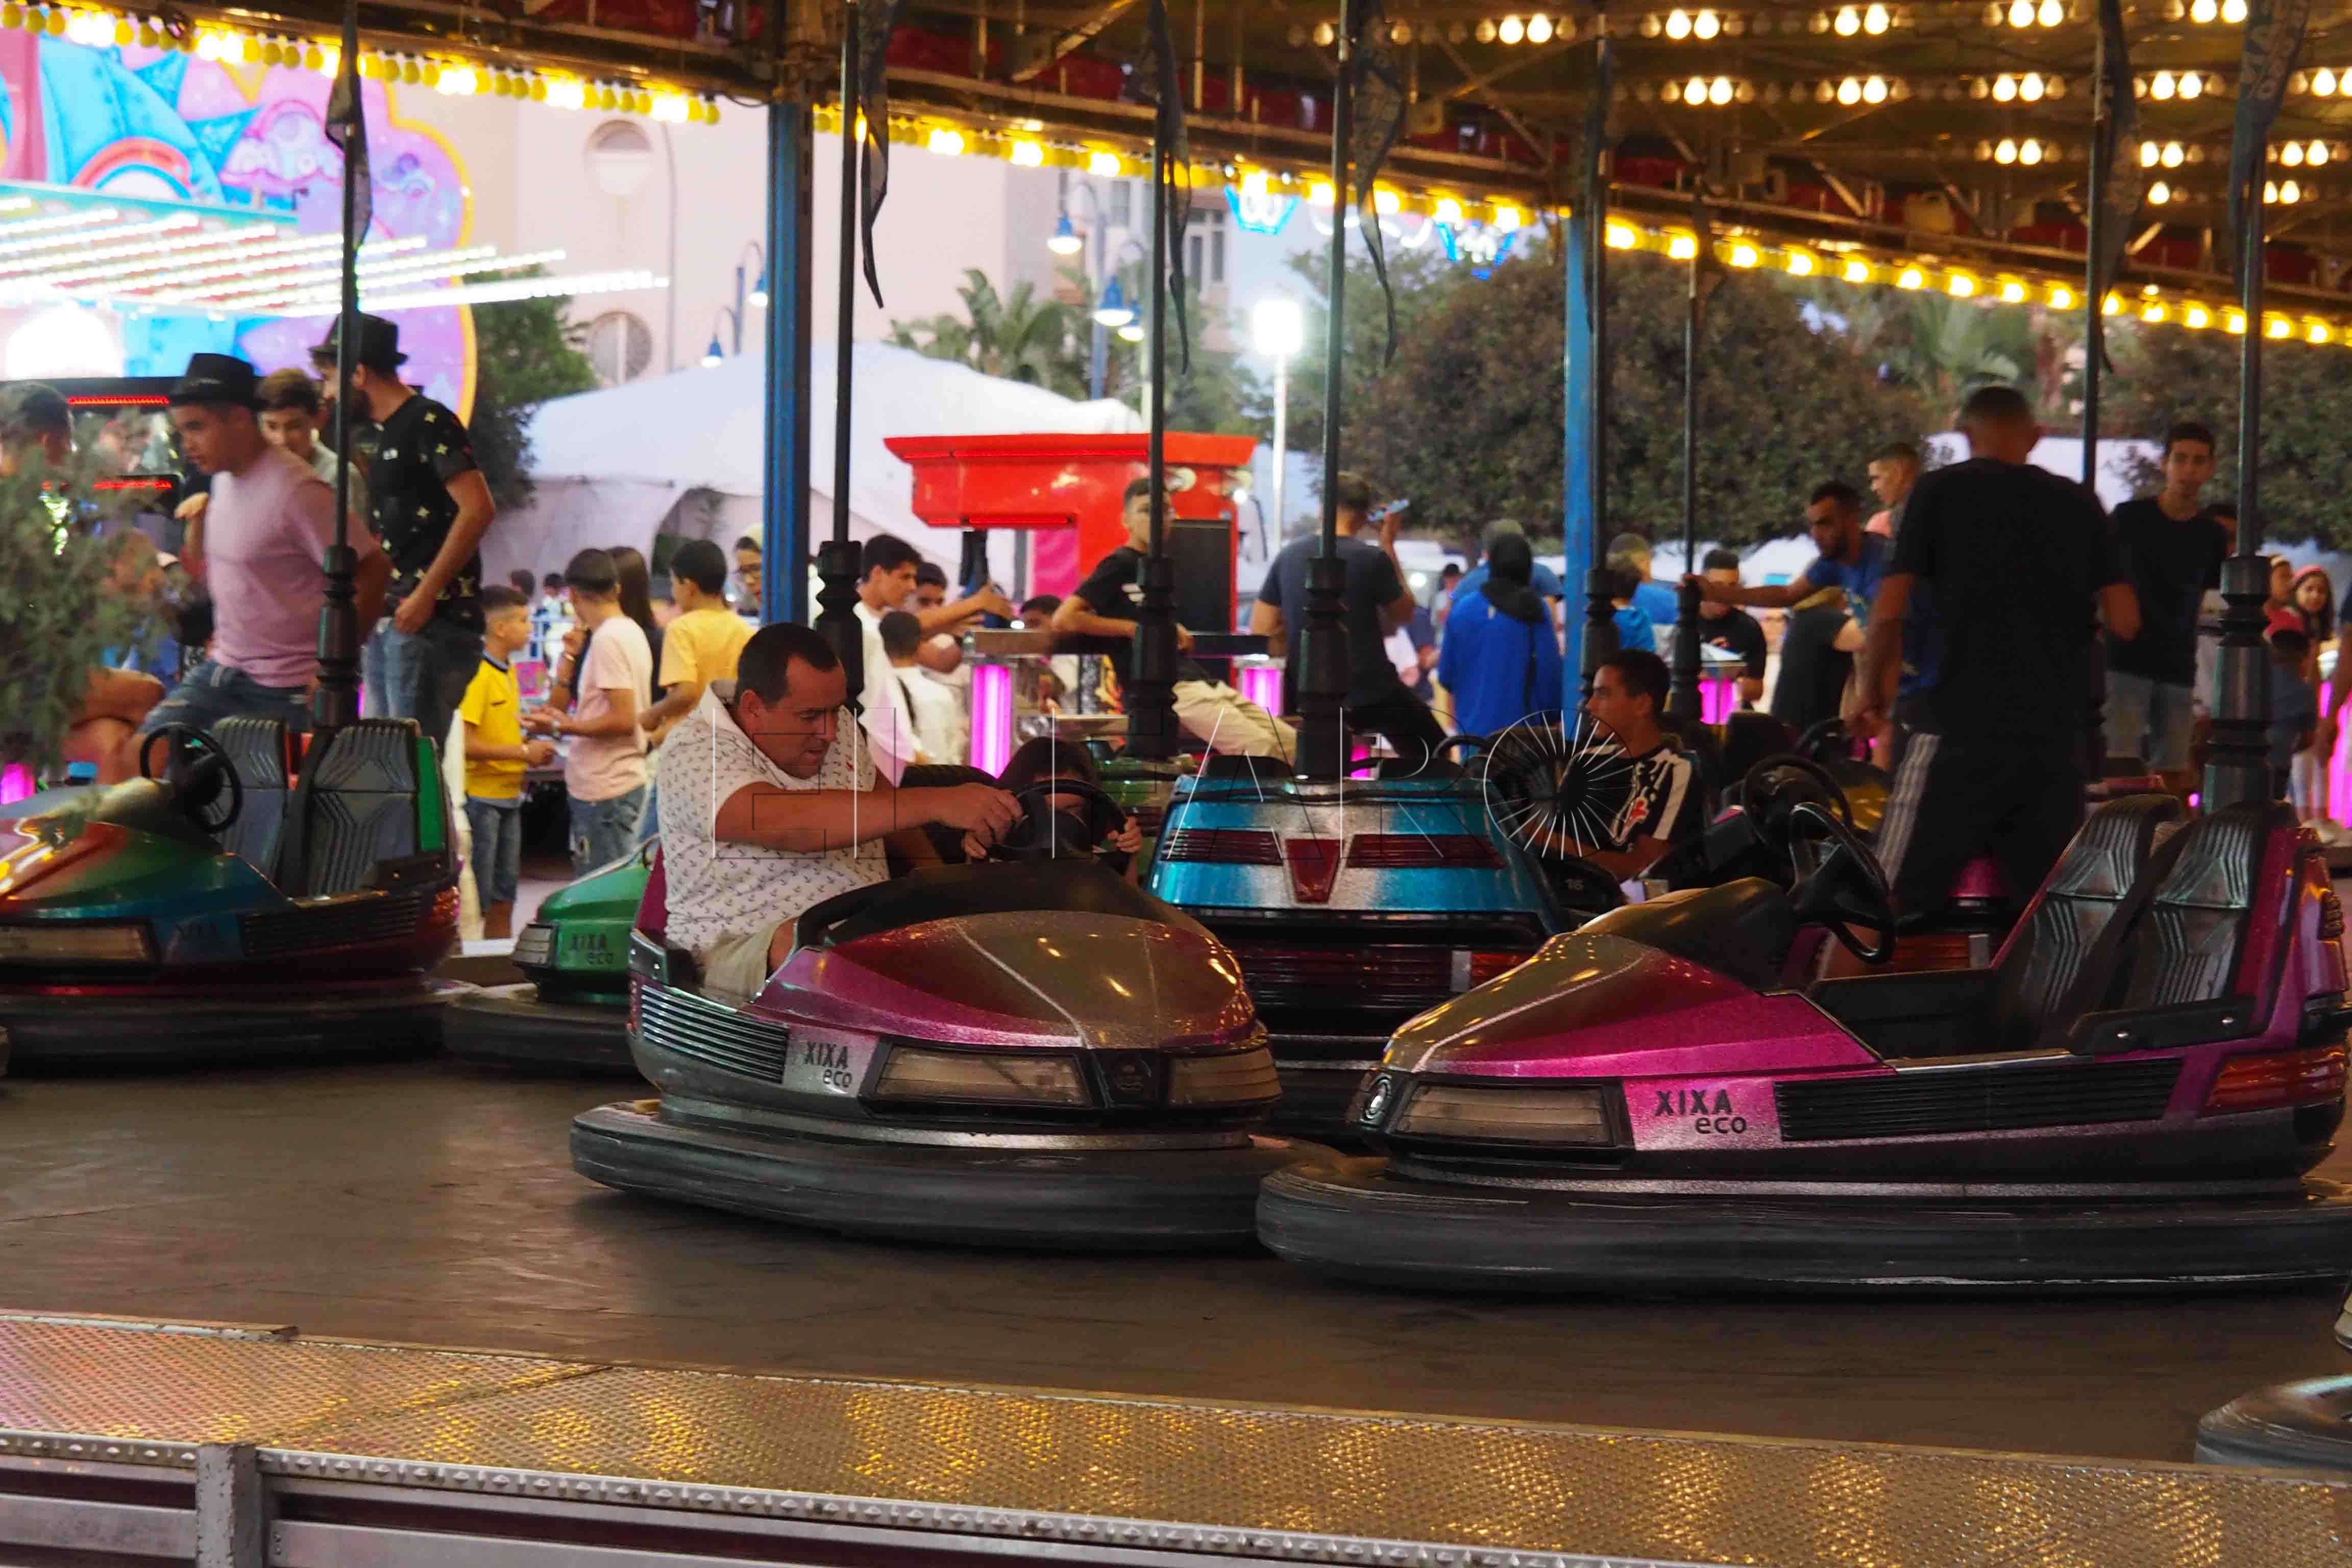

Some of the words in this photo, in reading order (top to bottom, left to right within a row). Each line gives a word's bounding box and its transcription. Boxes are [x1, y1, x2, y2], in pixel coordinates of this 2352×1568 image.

[588, 951, 614, 964] eco
[804, 1041, 849, 1069] XIXA
[823, 1069, 852, 1088] eco
[1655, 1089, 1732, 1116] XIXA
[1695, 1116, 1747, 1134] eco
